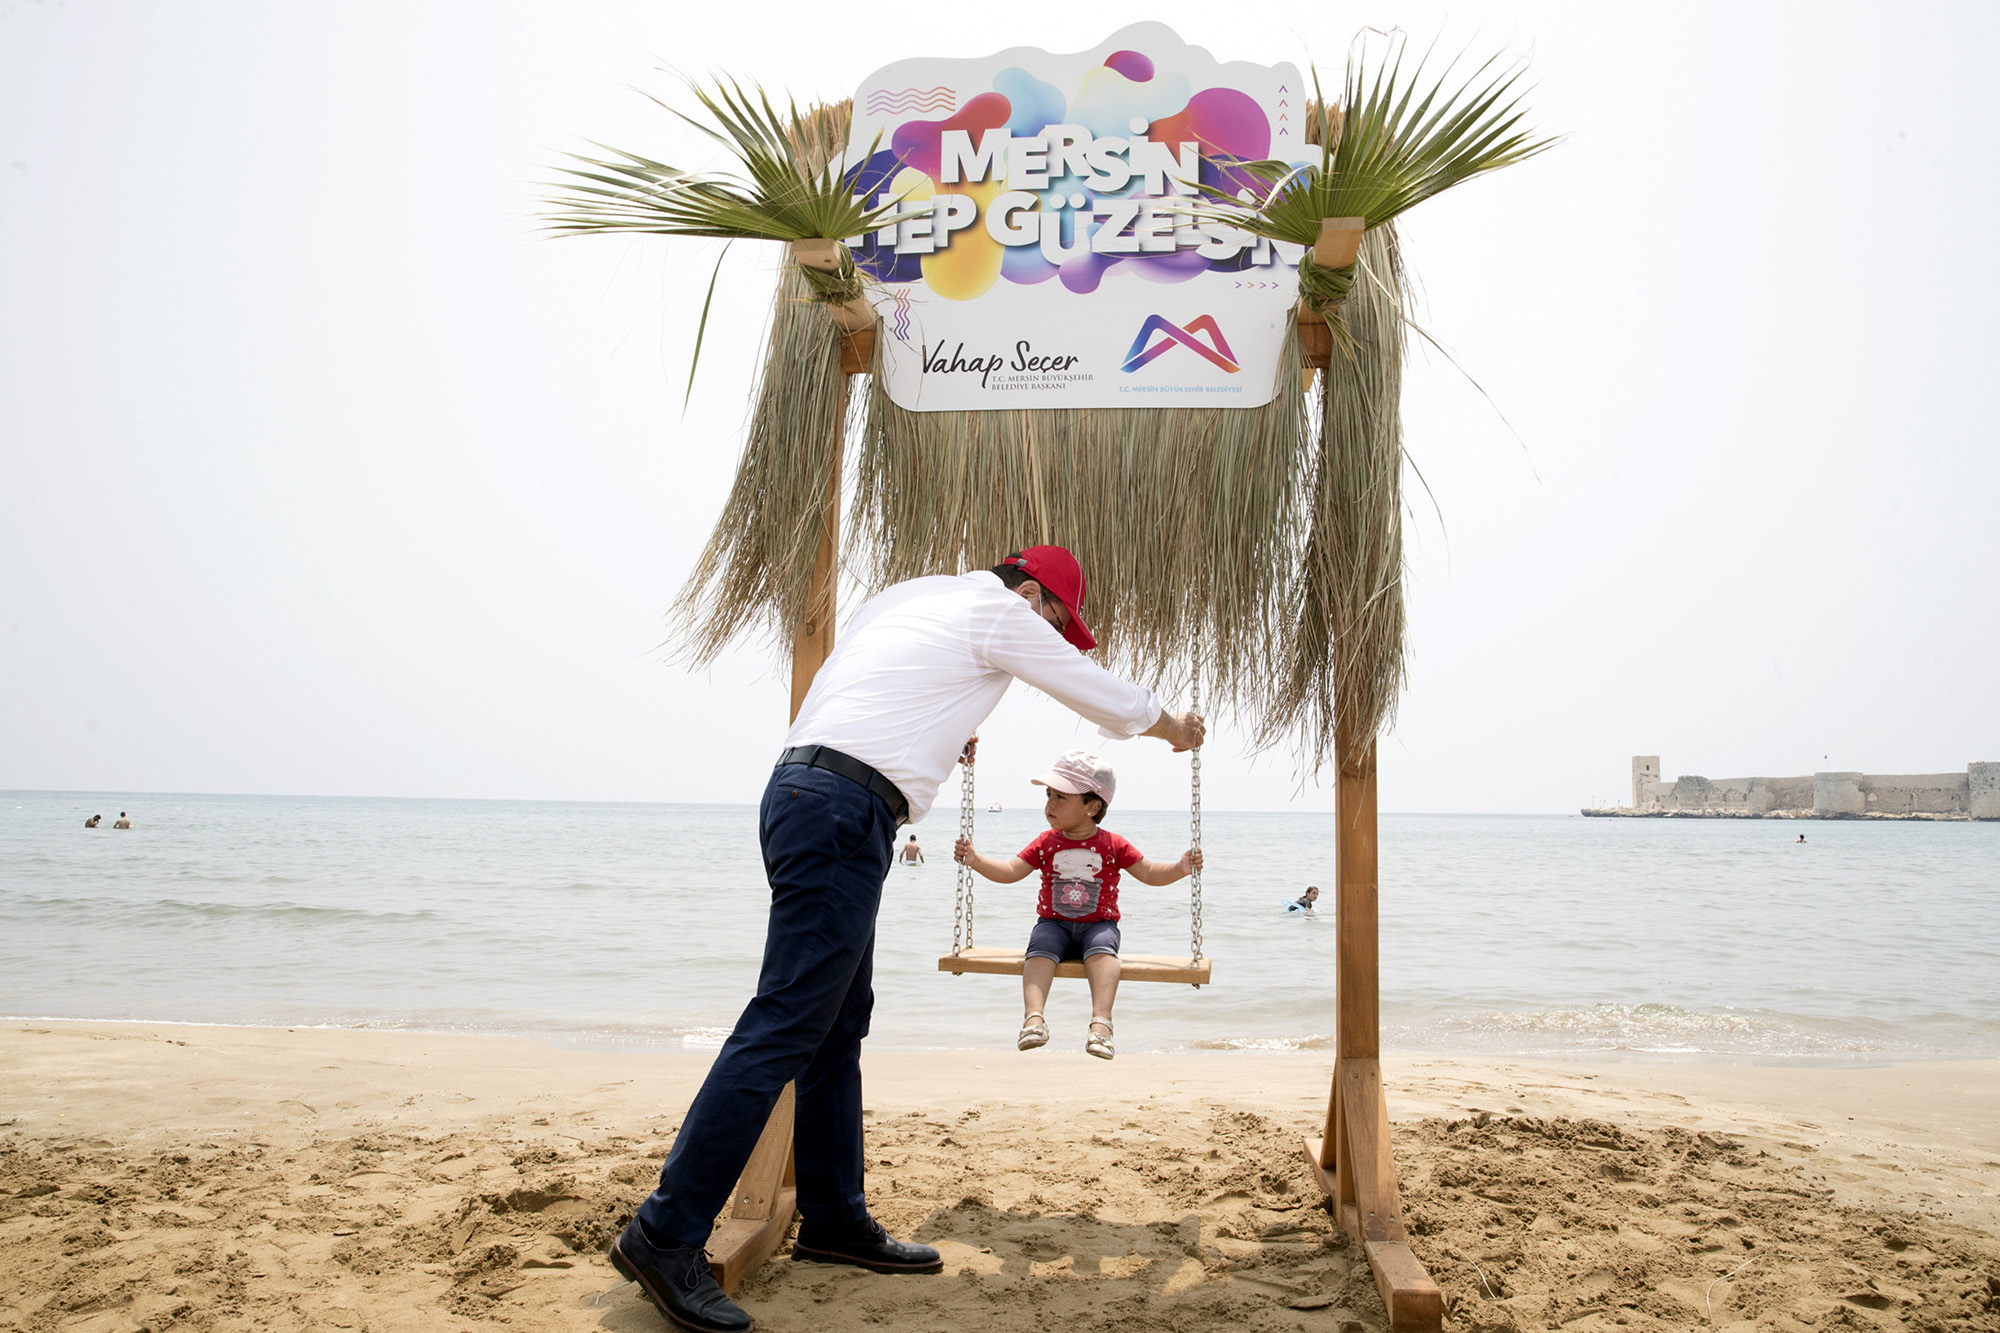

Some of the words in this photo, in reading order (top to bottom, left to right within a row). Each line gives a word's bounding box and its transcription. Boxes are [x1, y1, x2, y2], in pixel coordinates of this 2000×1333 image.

[940, 116, 1200, 194] MERSİN
[921, 339, 1004, 389] Vahap
[1010, 340, 1079, 373] Seçer
[991, 375, 1006, 383] T.C.
[1008, 374, 1040, 382] MERSİN
[1041, 373, 1094, 383] BÜYÜKŞEHİR
[991, 383, 1030, 391] BELEDİYE
[1031, 382, 1066, 391] BAŞKANI
